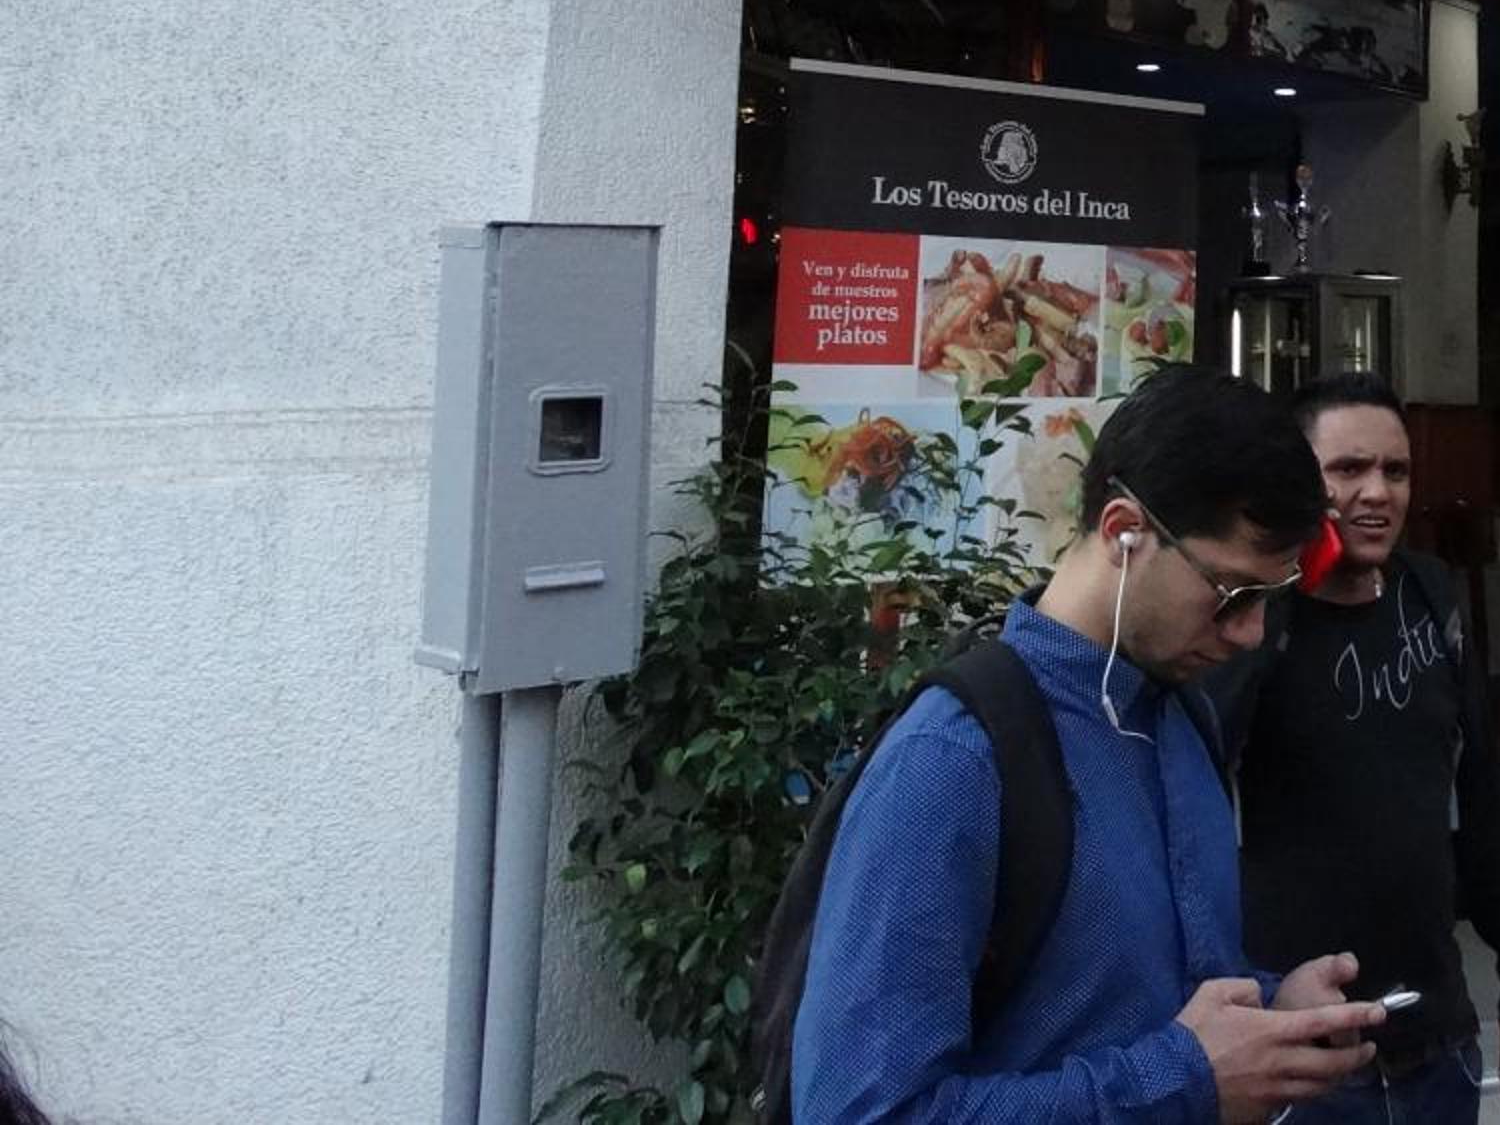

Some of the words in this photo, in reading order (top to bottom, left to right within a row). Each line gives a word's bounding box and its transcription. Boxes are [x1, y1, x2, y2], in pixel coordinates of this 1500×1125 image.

[872, 176, 922, 207] Los
[928, 180, 1029, 214] Tesoros
[1033, 189, 1072, 216] del
[1077, 192, 1131, 221] Inca
[803, 260, 833, 276] Ven
[837, 266, 847, 281] y
[851, 263, 909, 280] disfruta
[811, 280, 830, 296] de
[835, 285, 898, 298] nuestros
[808, 300, 899, 328] mejores
[816, 323, 888, 350] platos
